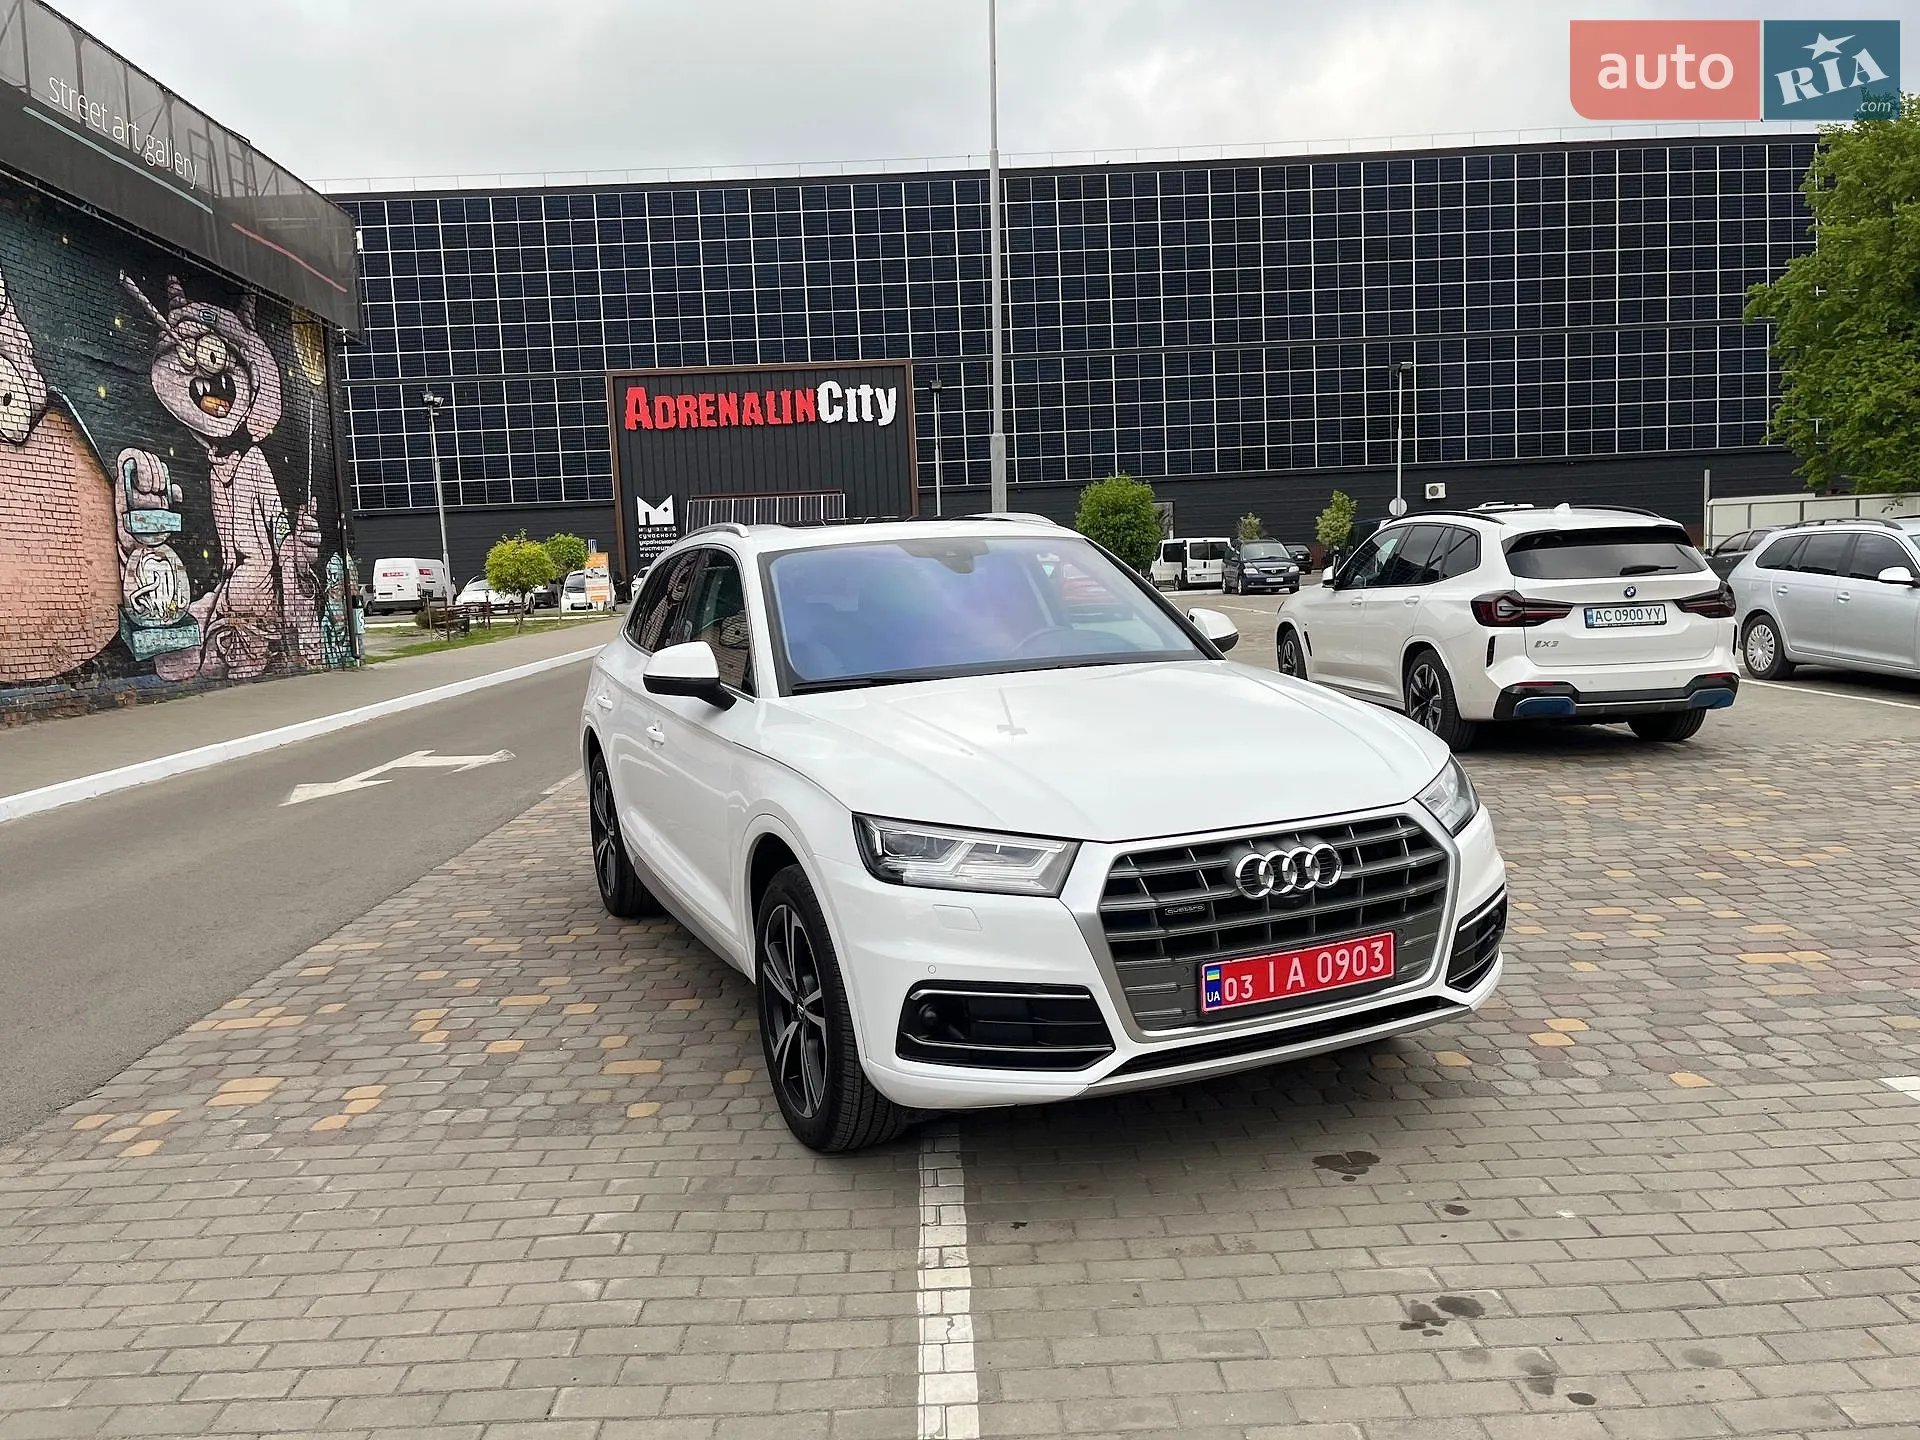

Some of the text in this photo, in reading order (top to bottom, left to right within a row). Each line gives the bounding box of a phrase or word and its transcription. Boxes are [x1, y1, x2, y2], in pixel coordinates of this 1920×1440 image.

[49, 76, 198, 190] street art gallery
[1595, 610, 1613, 623] AC
[1614, 608, 1643, 622] 0900
[1645, 607, 1661, 620] YY
[1224, 974, 1253, 1002] 03
[1316, 940, 1385, 985] 0903
[1206, 991, 1221, 1003] UA
